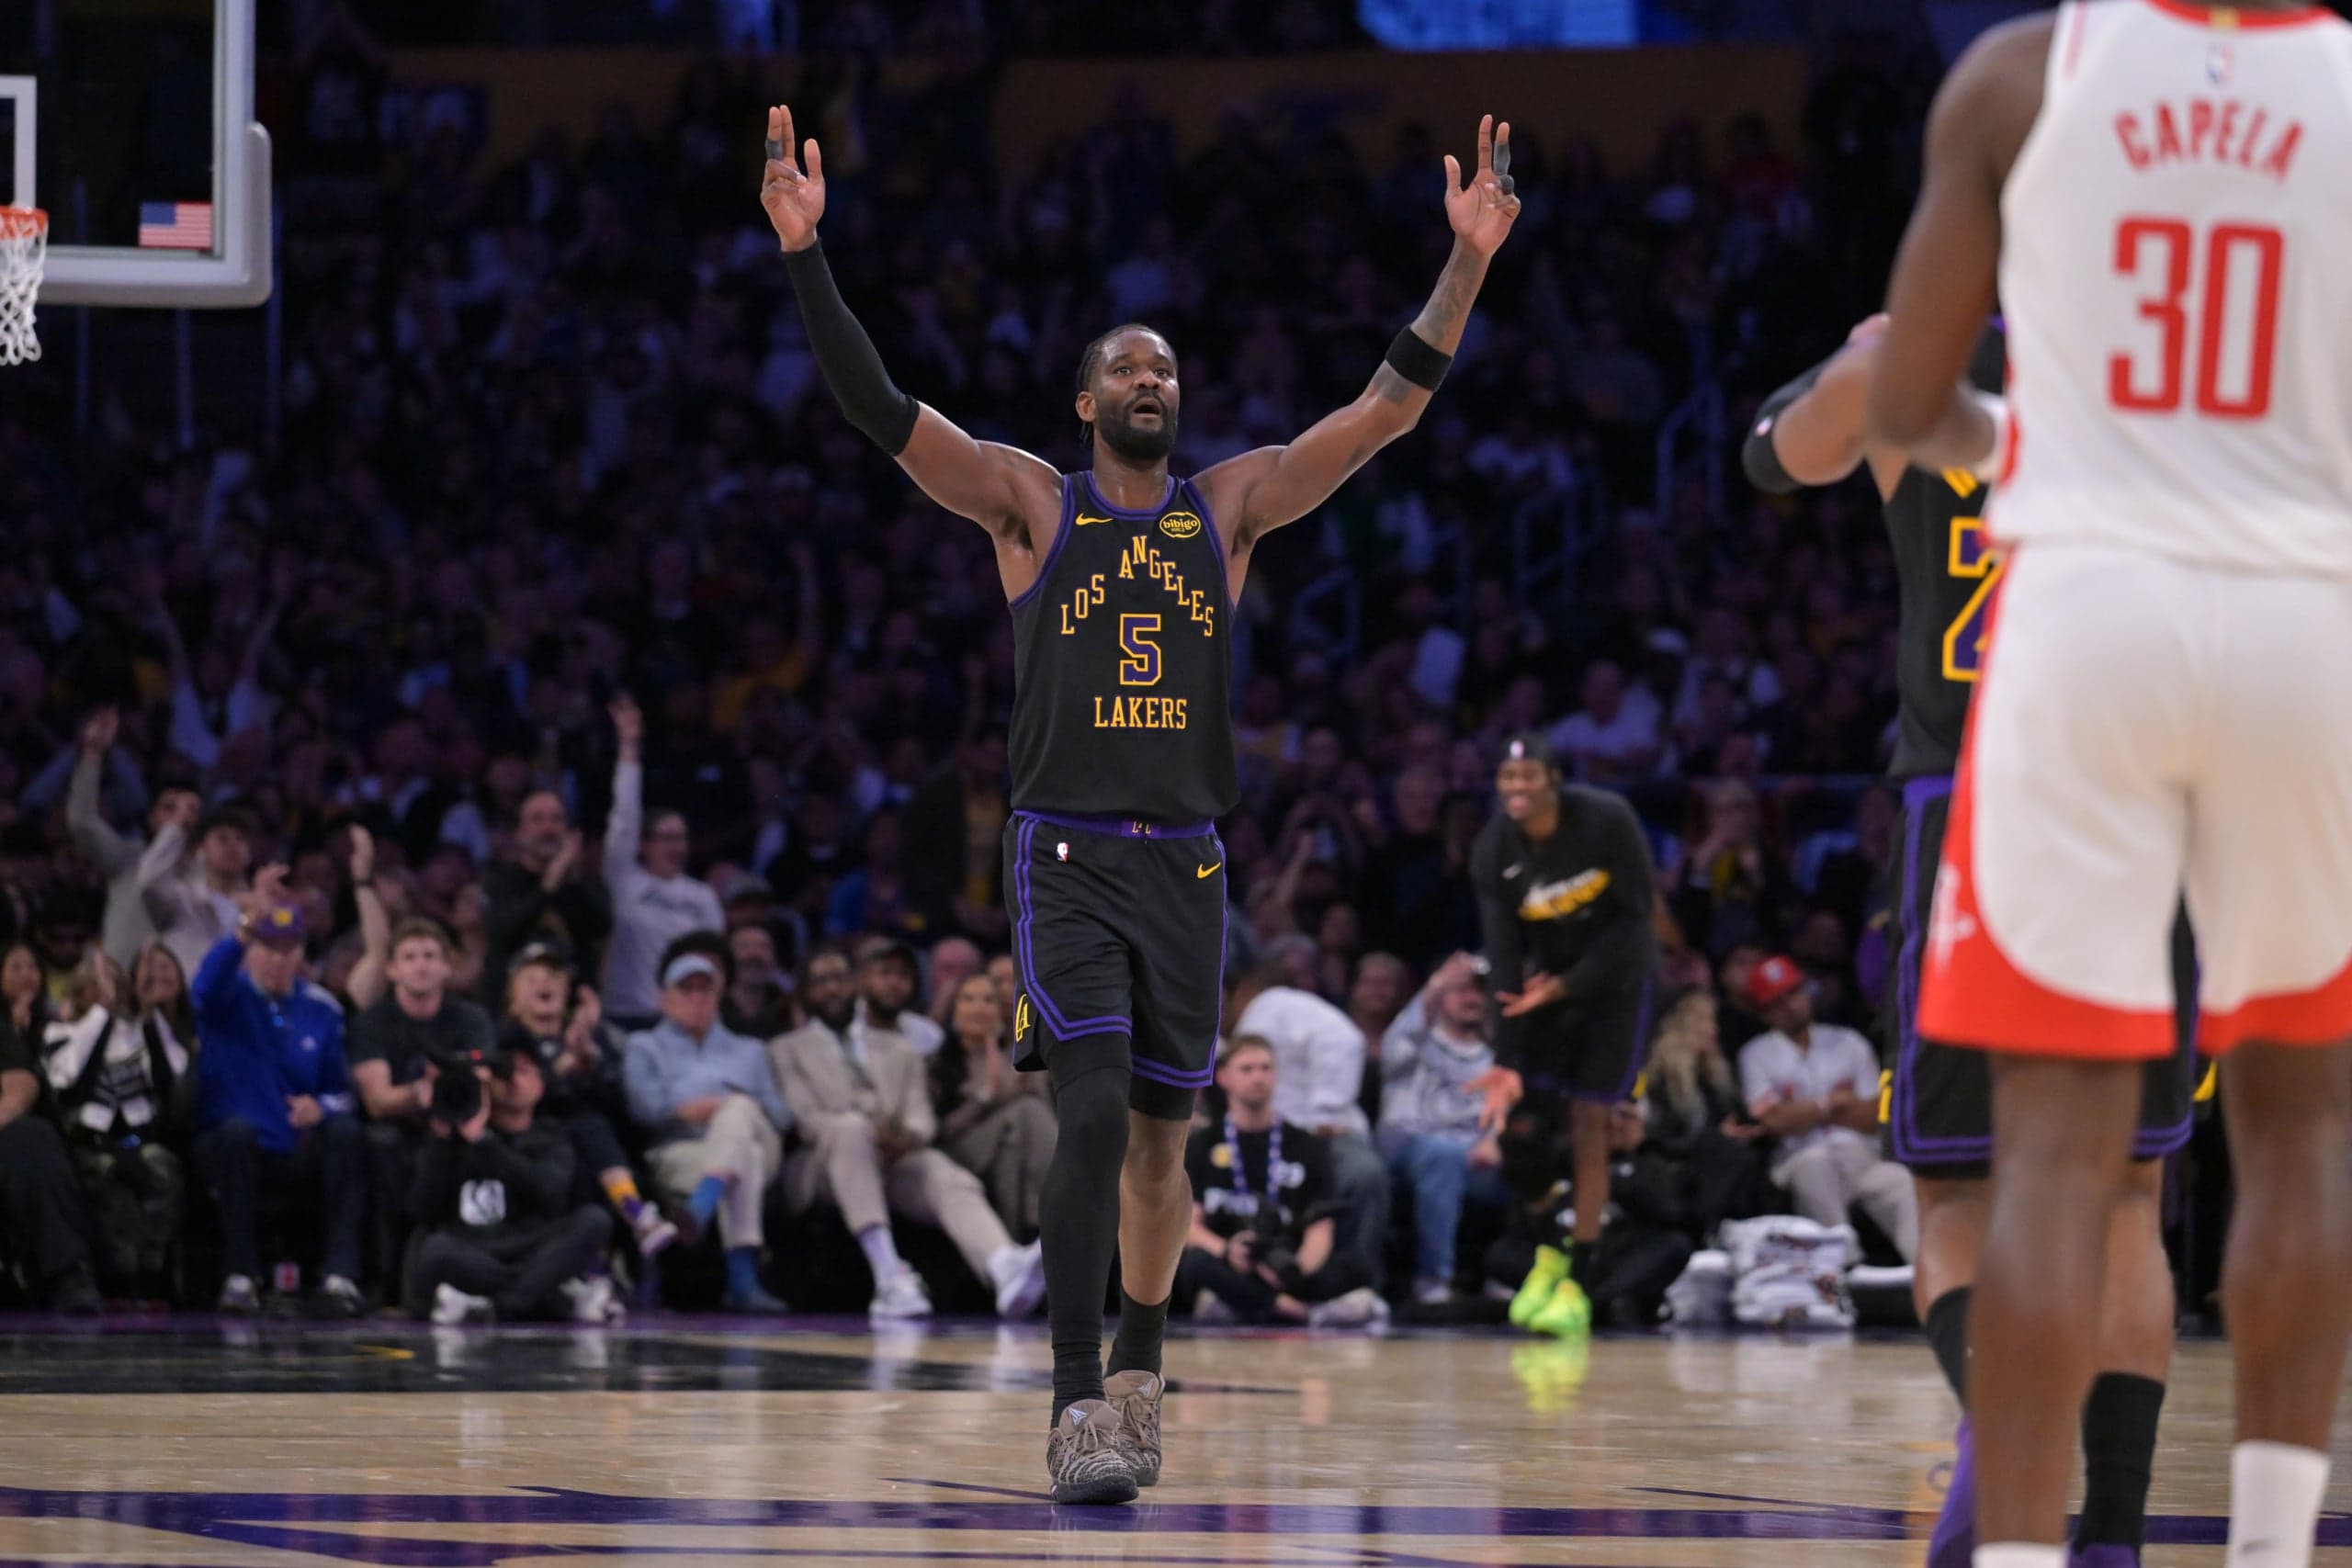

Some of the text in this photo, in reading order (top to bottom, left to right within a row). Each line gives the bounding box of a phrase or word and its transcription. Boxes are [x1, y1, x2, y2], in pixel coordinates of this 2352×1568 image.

[2113, 97, 2304, 183] CAPELA
[2107, 215, 2284, 421] 30
[1162, 518, 1198, 530] bibigo
[1060, 535, 1214, 637] LOS ANGELES
[1119, 613, 1162, 686] 5
[1094, 695, 1188, 729] LAKERS
